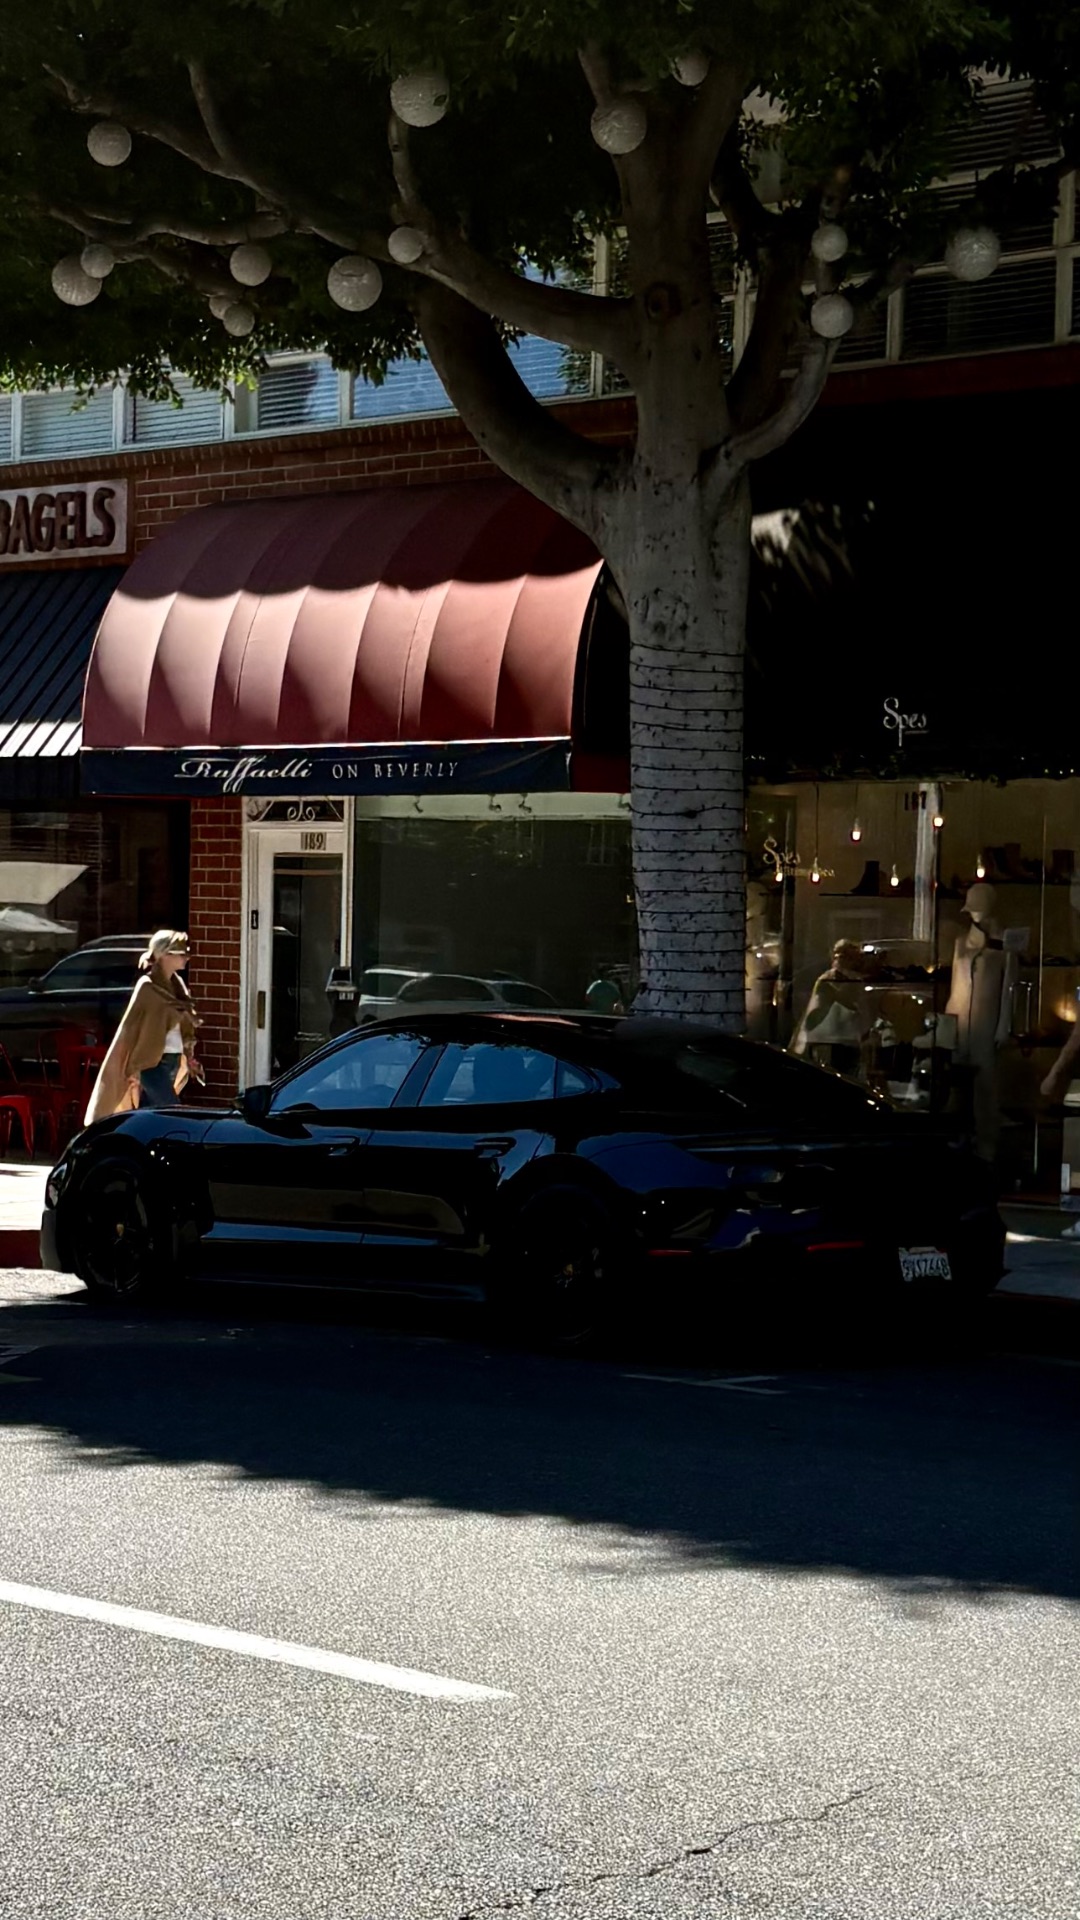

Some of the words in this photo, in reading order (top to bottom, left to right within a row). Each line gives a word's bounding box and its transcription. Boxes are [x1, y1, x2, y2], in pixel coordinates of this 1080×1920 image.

[883, 697, 929, 747] Spes
[173, 755, 313, 793] Raffaelli
[332, 763, 360, 779] ON
[374, 761, 459, 779] BEVERLY
[304, 831, 324, 850] 189
